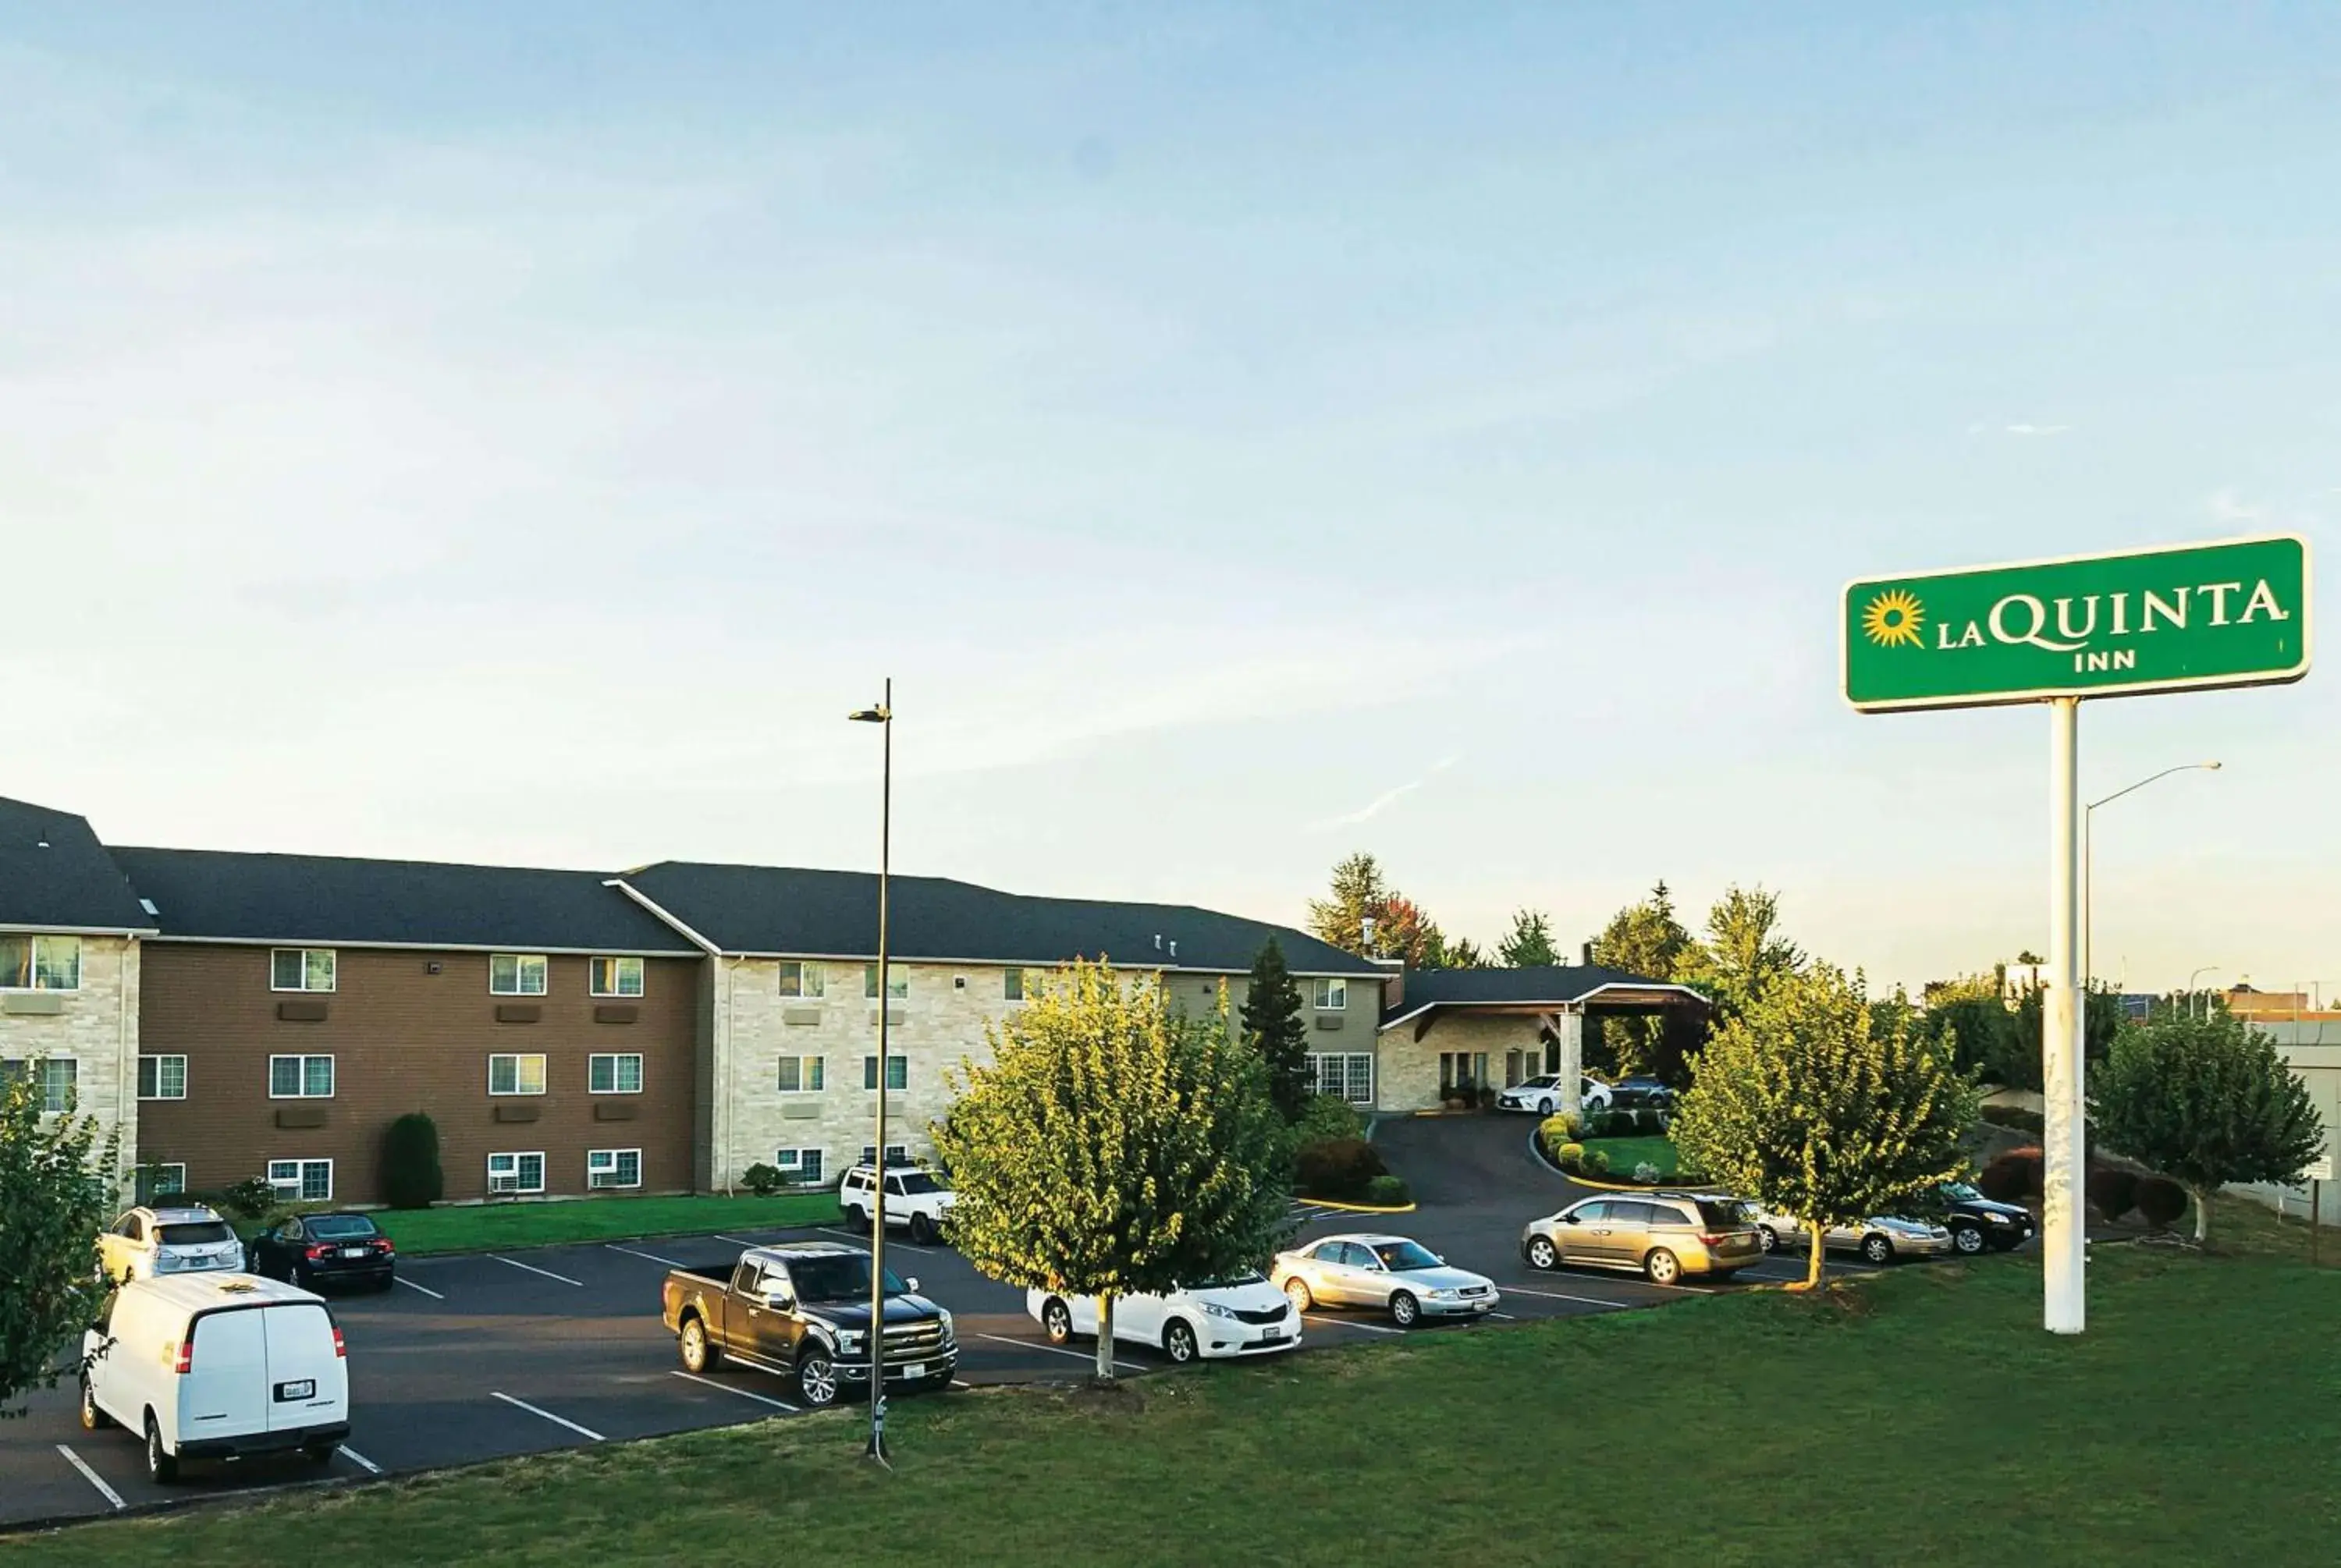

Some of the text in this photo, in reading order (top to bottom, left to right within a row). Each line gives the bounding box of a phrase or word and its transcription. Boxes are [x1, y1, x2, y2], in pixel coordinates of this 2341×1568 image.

[1938, 579, 2283, 651] LA QUINTA
[2075, 649, 2135, 672] INN
